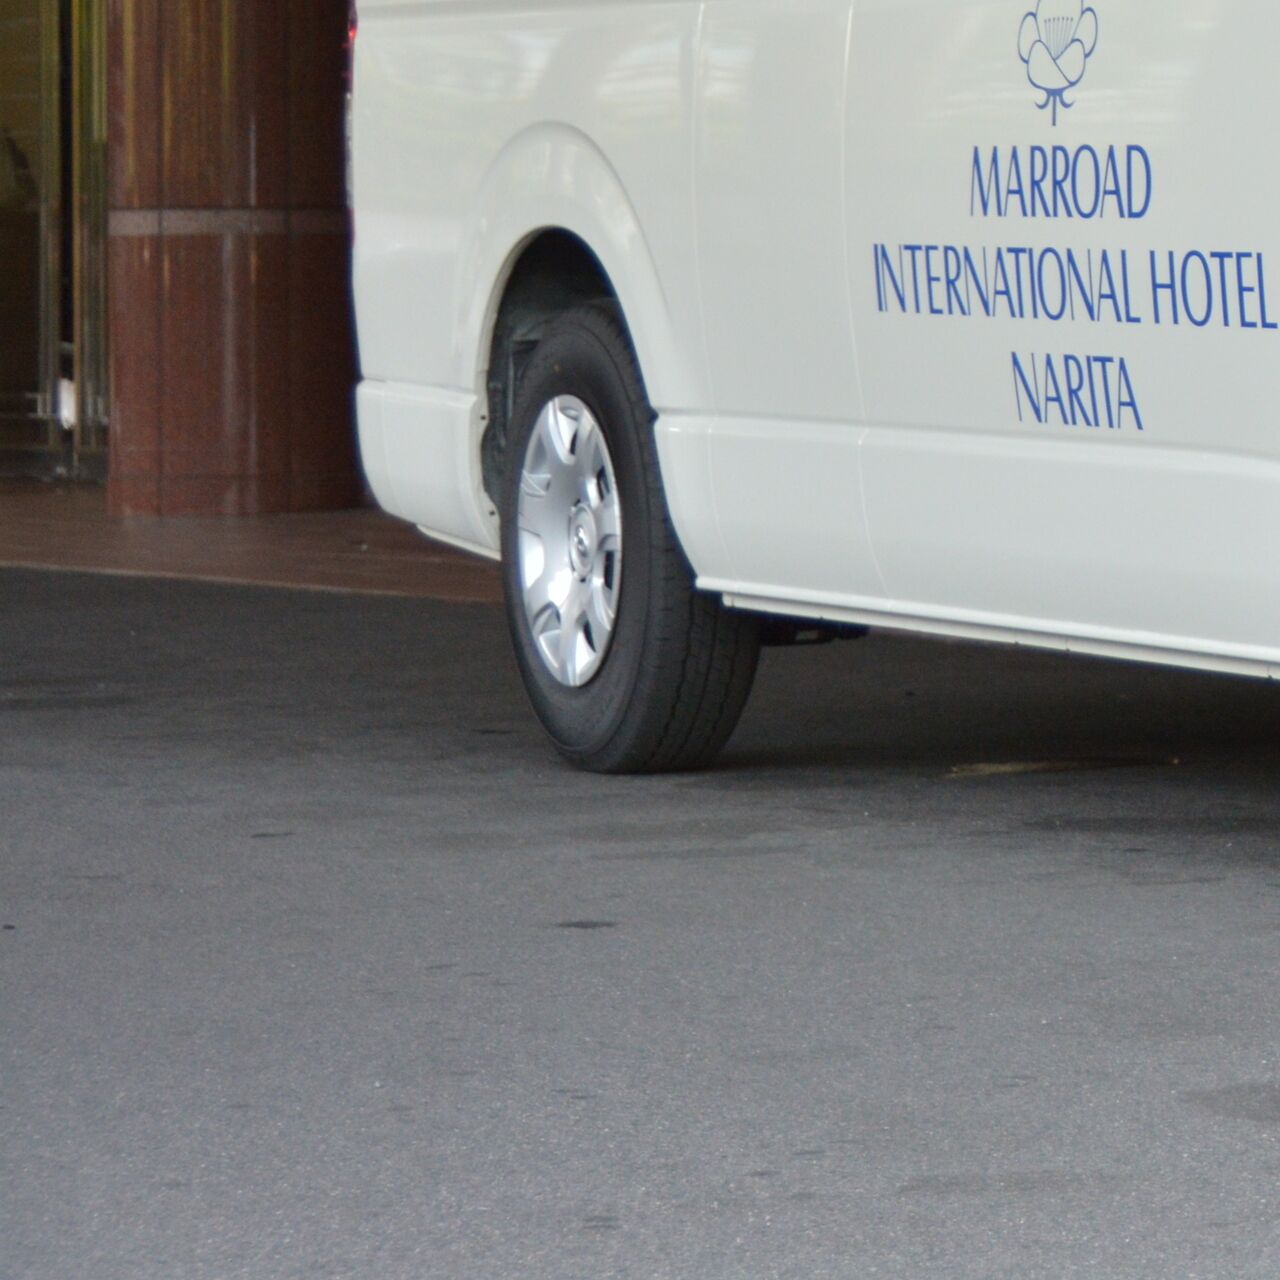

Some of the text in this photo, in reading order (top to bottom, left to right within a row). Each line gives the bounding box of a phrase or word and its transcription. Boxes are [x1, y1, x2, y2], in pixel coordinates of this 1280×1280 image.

[970, 144, 1152, 219] MARROAD
[873, 243, 1279, 330] INTERNATIONAL HOTEL
[1010, 350, 1144, 431] NARITA
